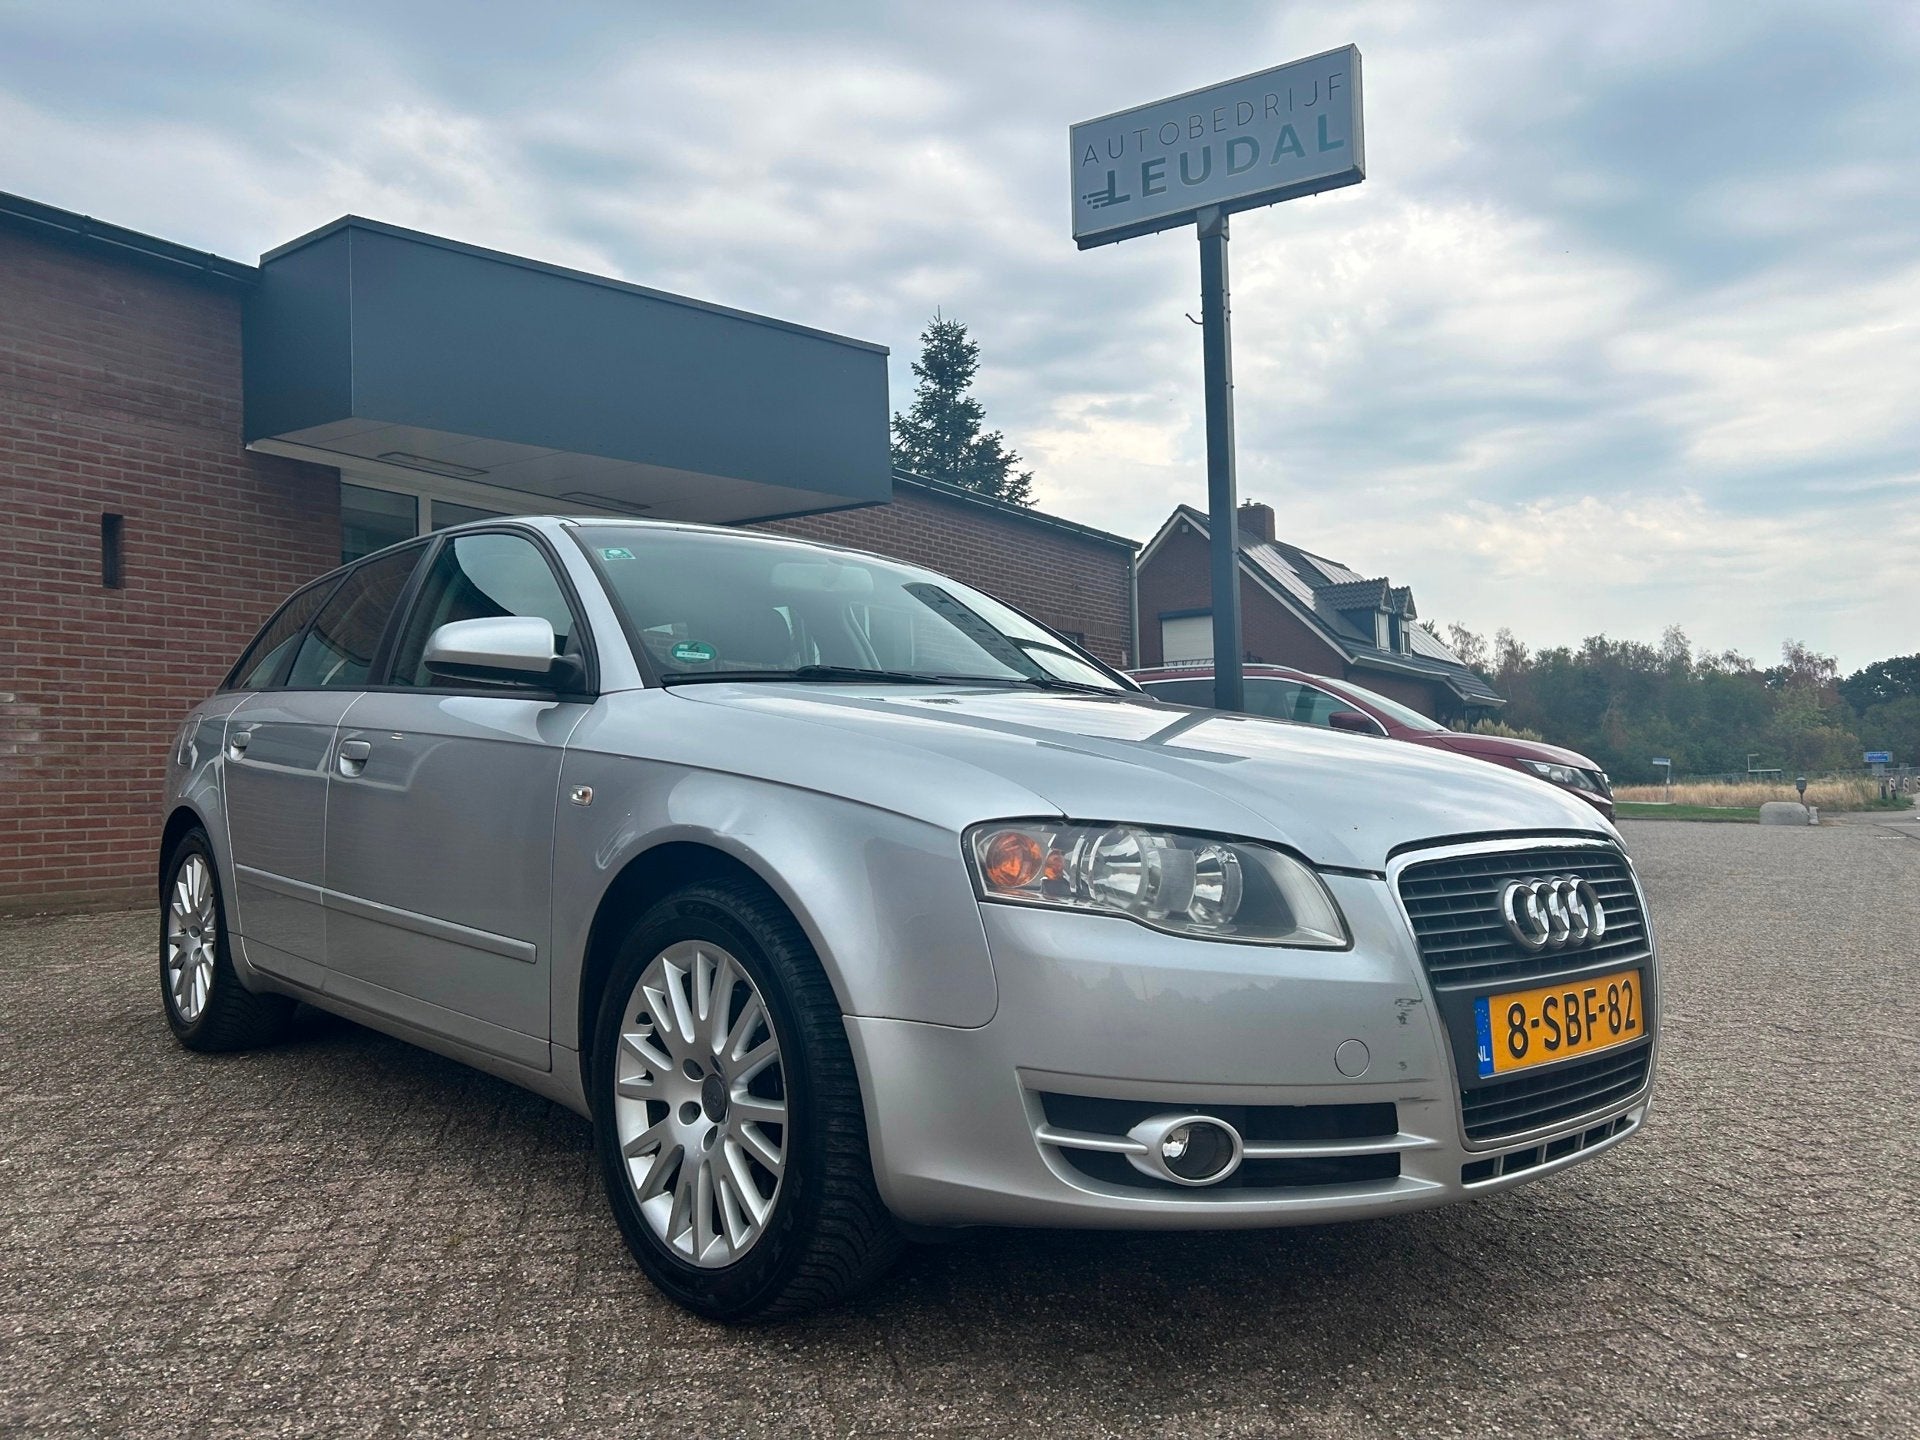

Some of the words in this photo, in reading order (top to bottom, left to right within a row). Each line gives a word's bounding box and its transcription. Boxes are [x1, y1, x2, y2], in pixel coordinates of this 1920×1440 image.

[1082, 72, 1343, 168] AUTOBEDRIJF
[1086, 113, 1345, 209] LEUDAL
[1507, 979, 1636, 1059] 8-SBF-82
